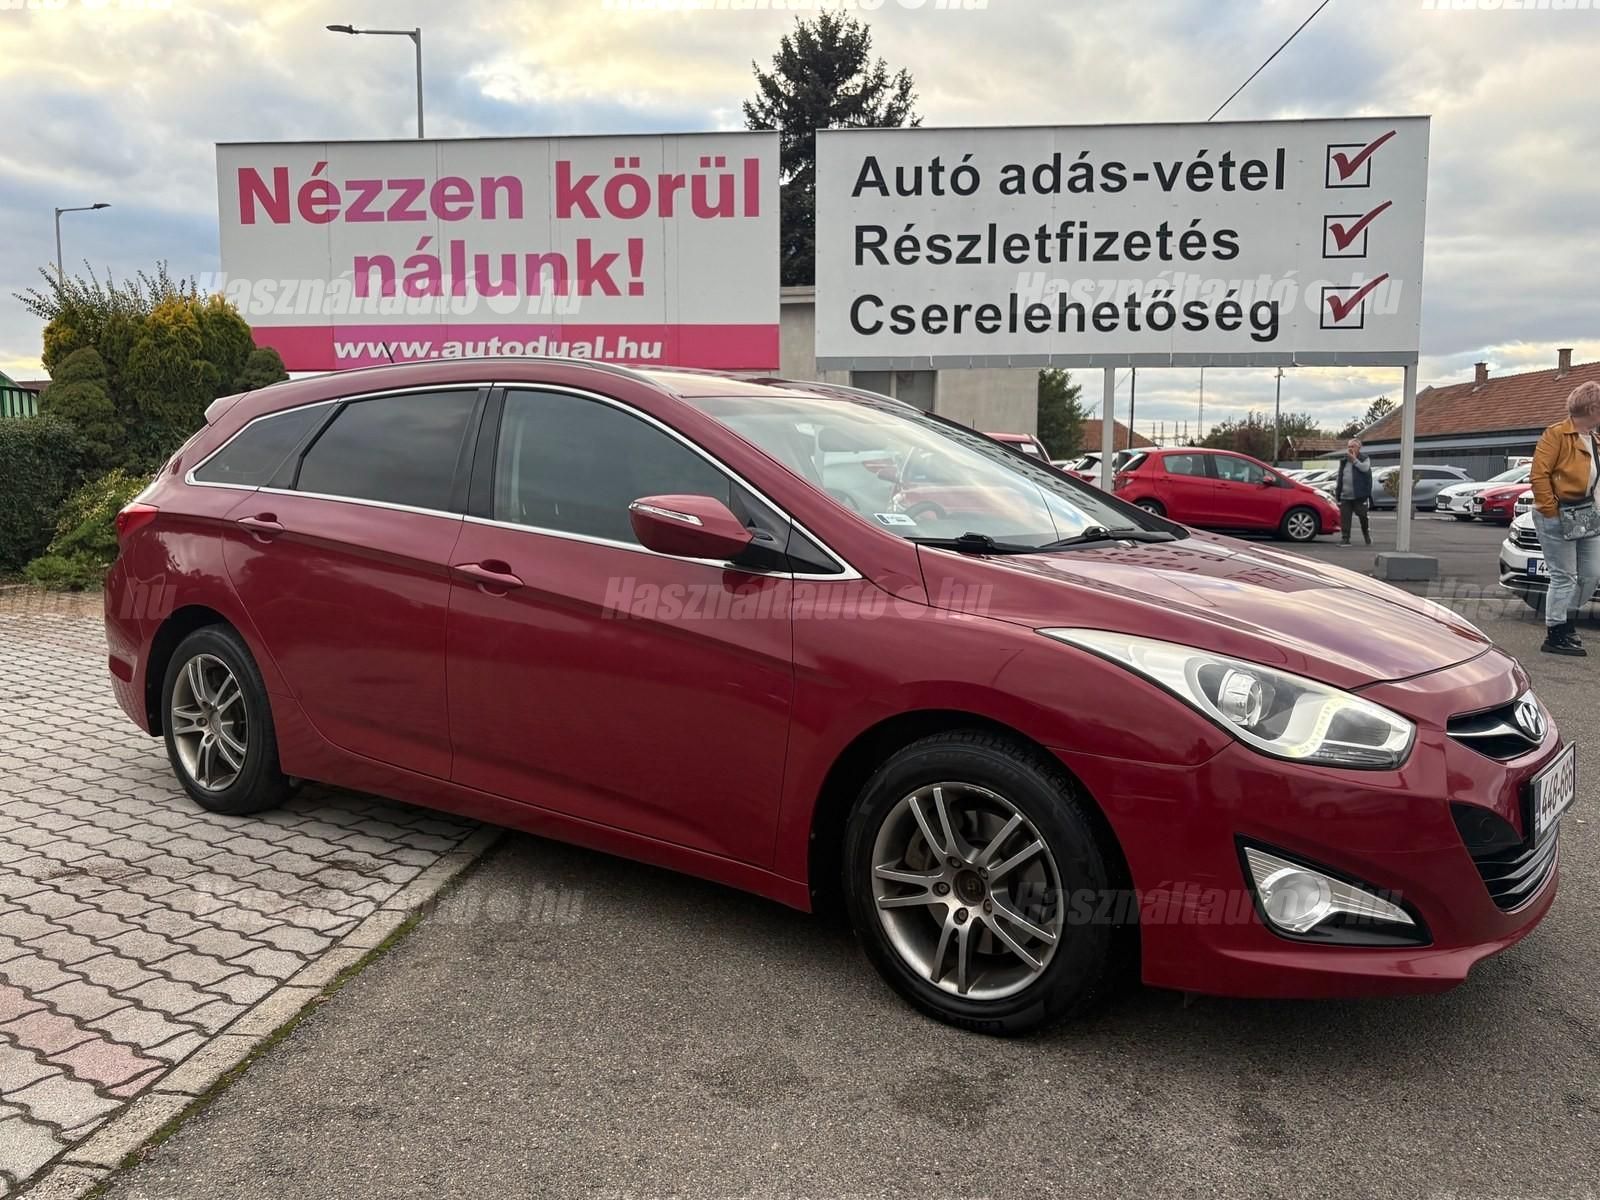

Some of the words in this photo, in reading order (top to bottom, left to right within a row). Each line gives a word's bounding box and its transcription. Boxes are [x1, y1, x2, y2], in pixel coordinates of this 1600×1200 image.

[237, 161, 523, 225] Nézzen
[555, 156, 760, 220] körül
[851, 153, 981, 198] Autó
[999, 147, 1286, 196] adás-vétel
[354, 236, 645, 298] nálunk!
[855, 218, 1240, 266] Részletfizetés
[850, 289, 1279, 343] Cserelehetőség
[334, 335, 663, 361] www.autodual.hu
